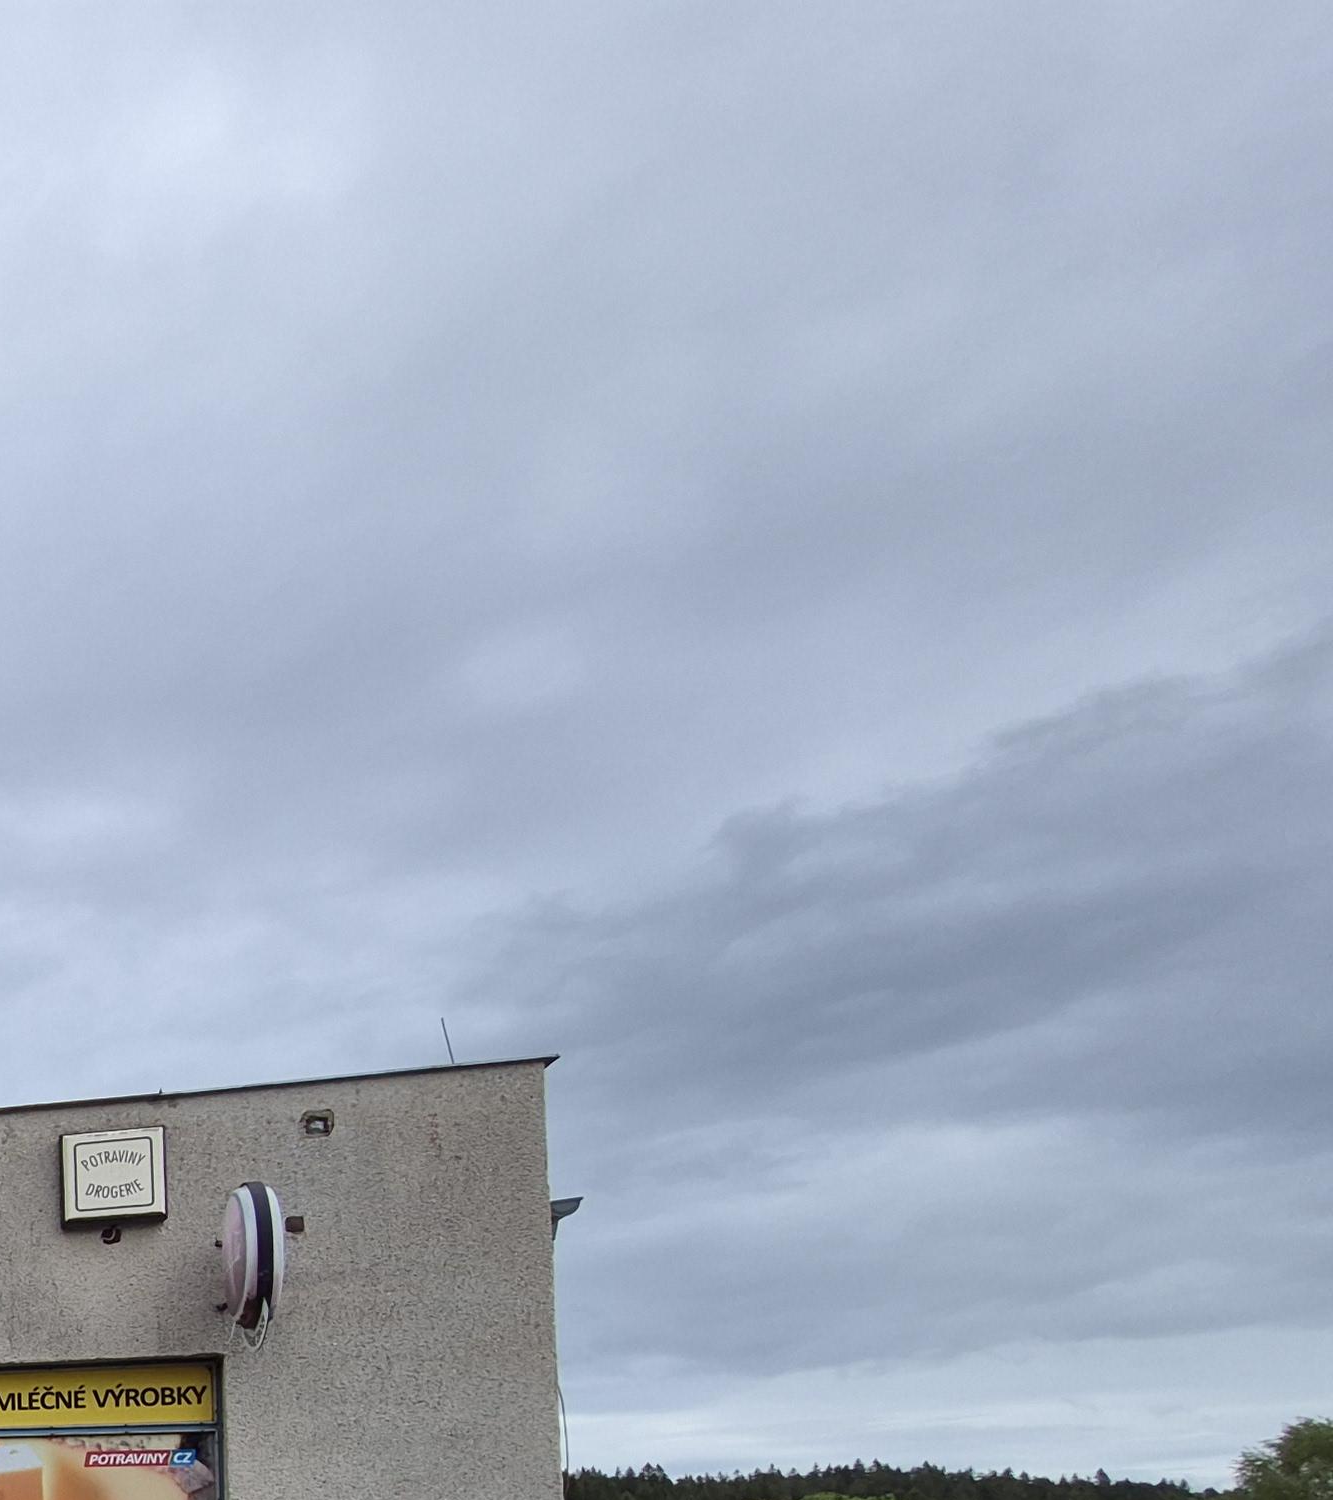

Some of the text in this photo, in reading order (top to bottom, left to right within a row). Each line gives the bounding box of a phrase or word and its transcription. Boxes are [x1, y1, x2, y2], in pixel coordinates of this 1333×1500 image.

[80, 1149, 146, 1171] POTRAVINY
[85, 1178, 144, 1199] DROGERIE
[93, 1383, 208, 1409] VÝROBKY
[88, 1451, 193, 1466] POTRAVINY CZ
